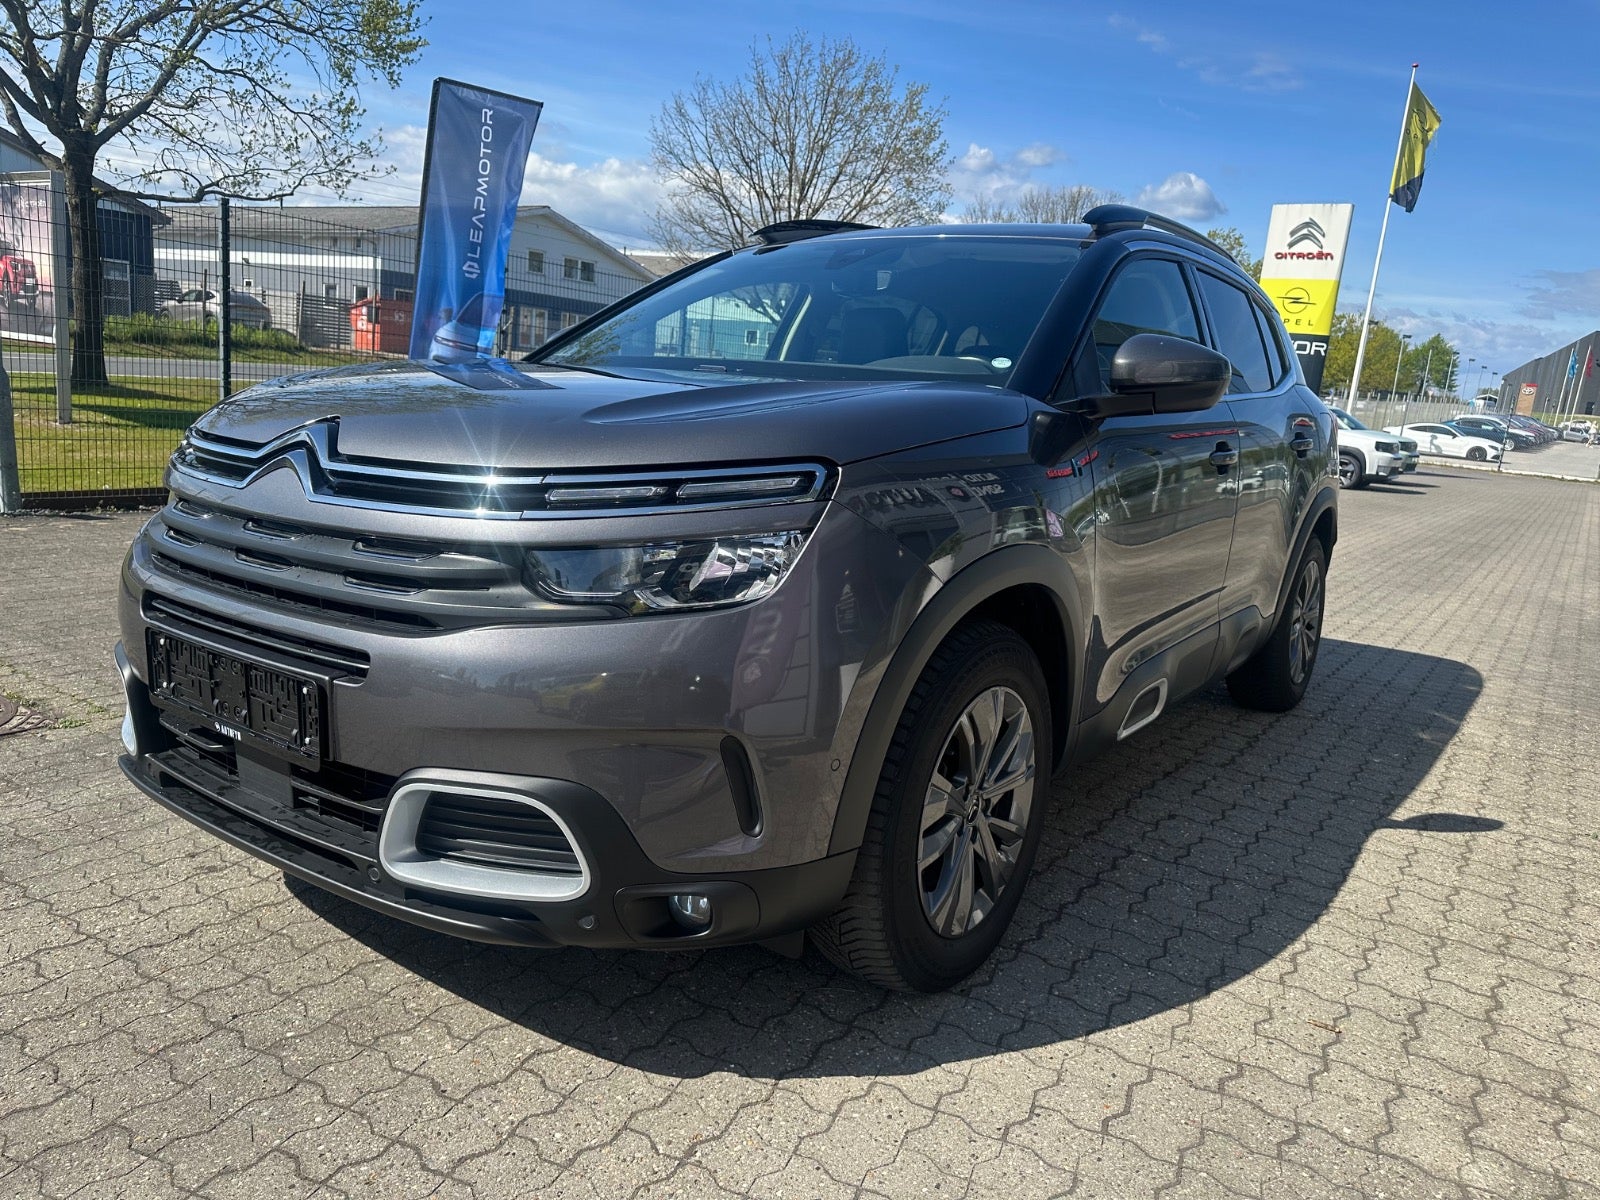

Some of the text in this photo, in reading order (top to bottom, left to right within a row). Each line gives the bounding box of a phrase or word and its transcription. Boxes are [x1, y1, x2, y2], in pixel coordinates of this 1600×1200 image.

[466, 108, 494, 259] LEAPMOTOR
[1274, 250, 1334, 261] CITROËN
[1283, 318, 1314, 326] PEL
[1291, 340, 1328, 356] OR
